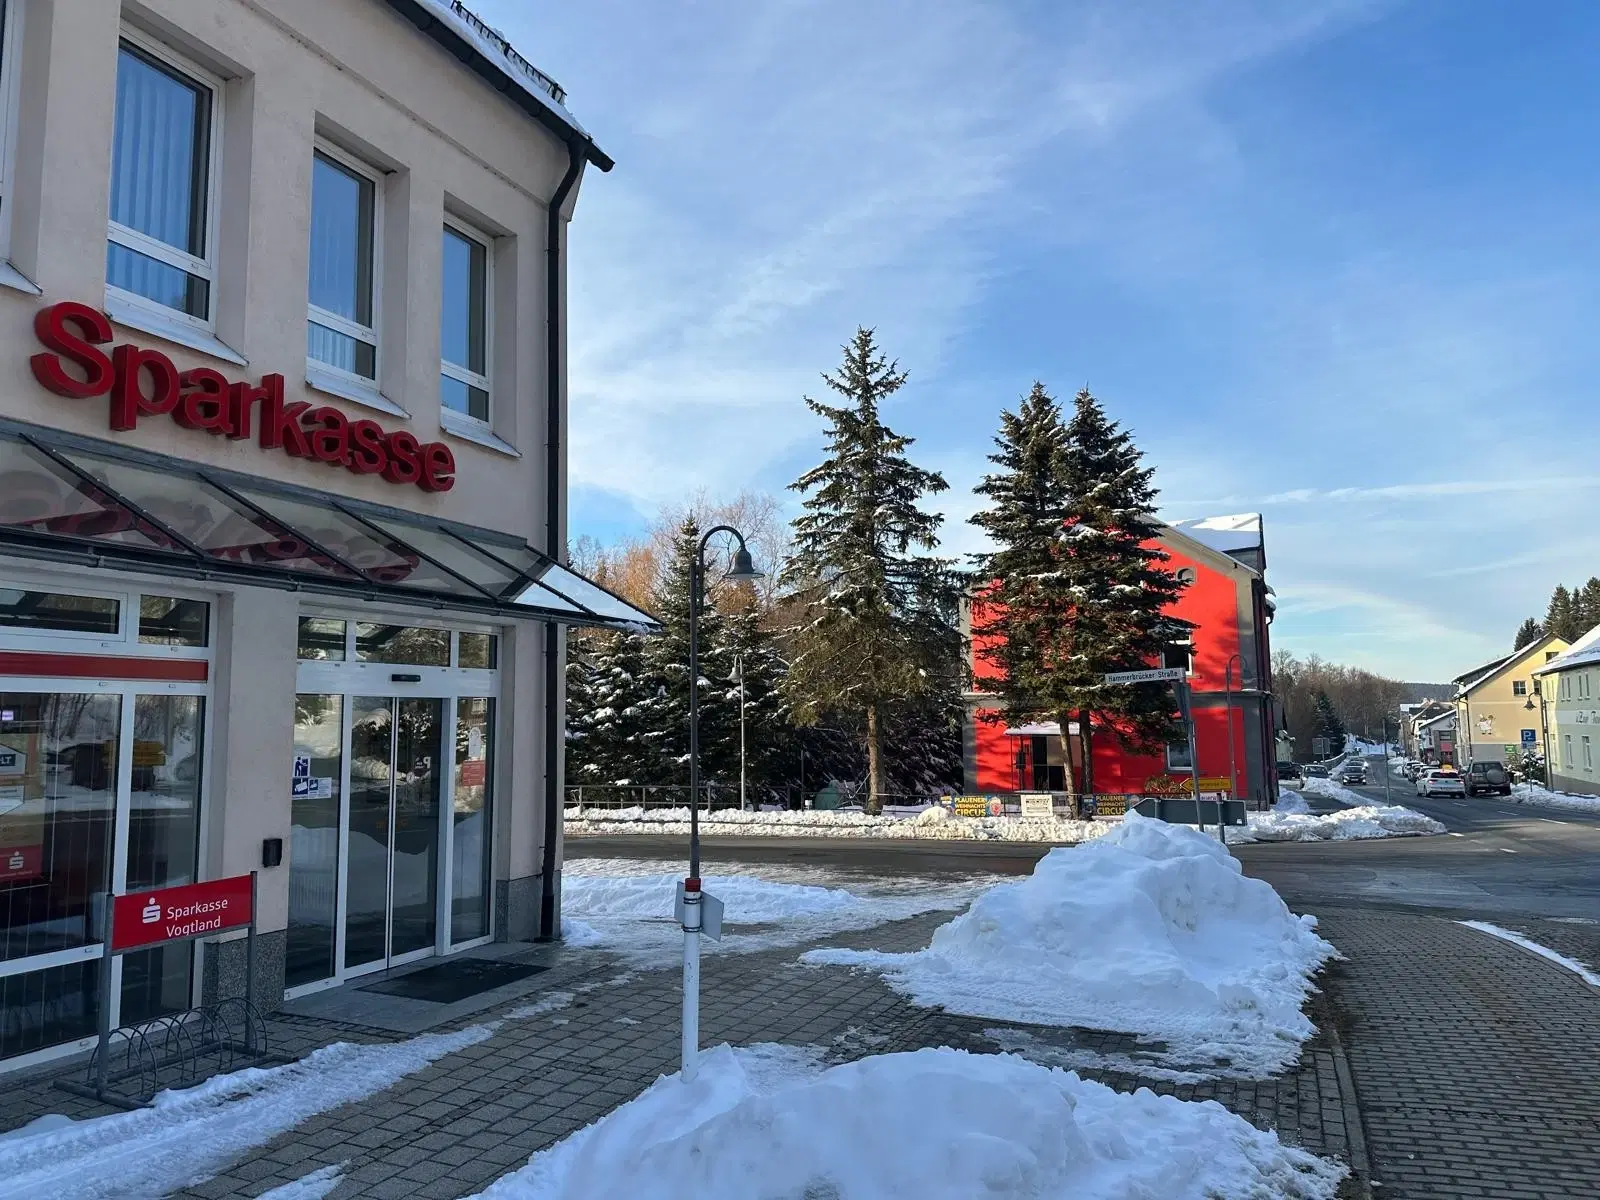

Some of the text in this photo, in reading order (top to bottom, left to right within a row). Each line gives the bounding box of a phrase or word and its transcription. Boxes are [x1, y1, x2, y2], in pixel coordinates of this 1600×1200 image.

[31, 301, 457, 493] Sparkasse
[1108, 670, 1178, 682] Hammerbrücker Straße
[954, 808, 986, 817] CIRCUS
[1096, 807, 1126, 815] CIRCUS
[166, 899, 228, 921] Sparkasse
[166, 916, 221, 938] Vogtland
